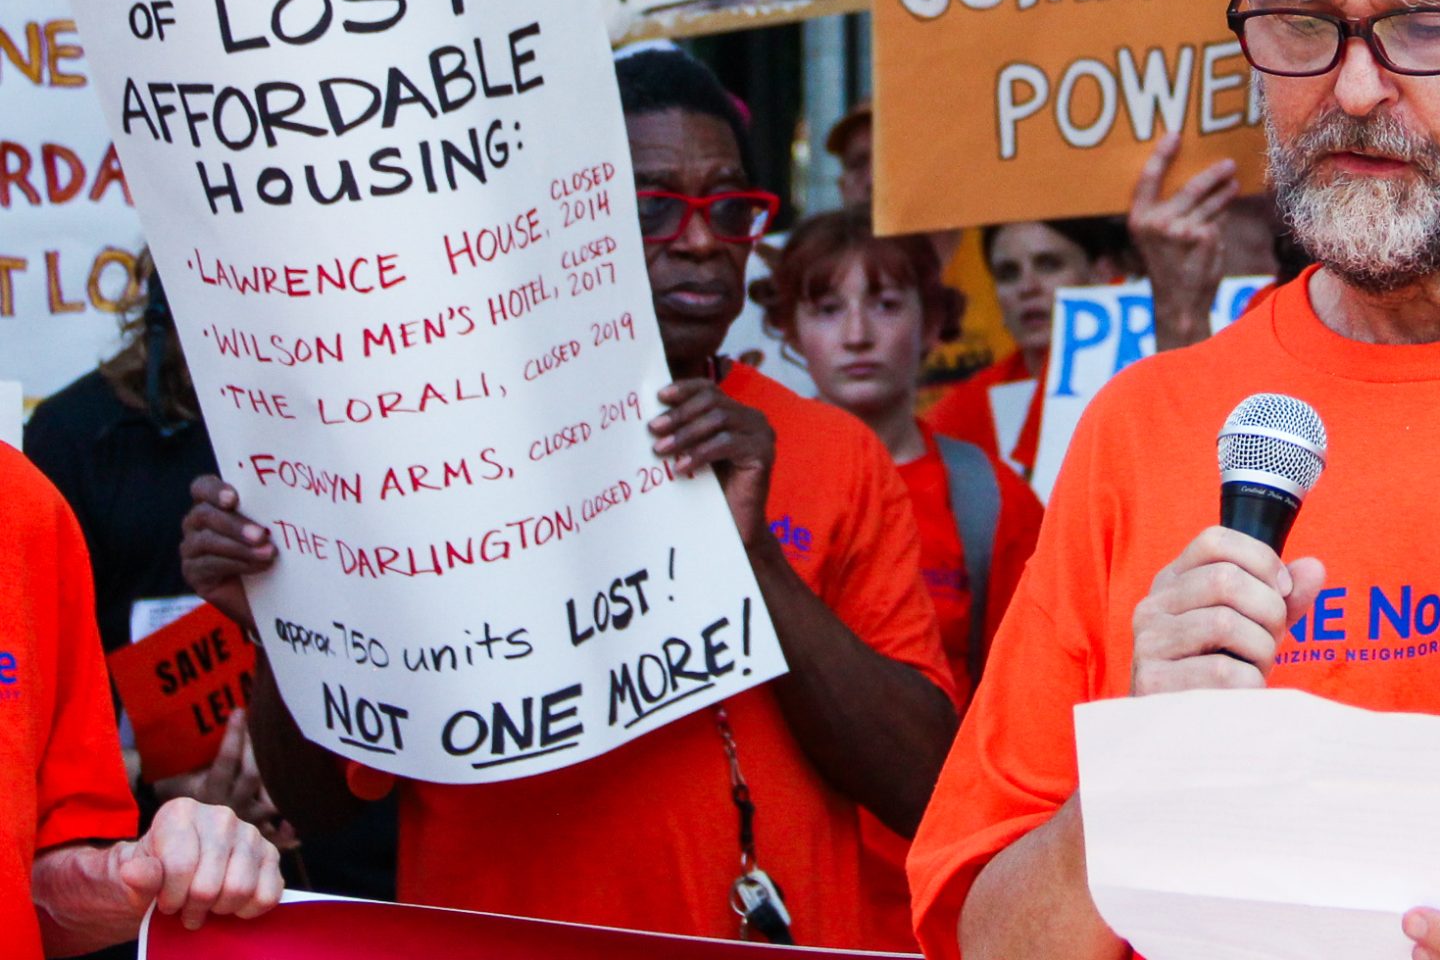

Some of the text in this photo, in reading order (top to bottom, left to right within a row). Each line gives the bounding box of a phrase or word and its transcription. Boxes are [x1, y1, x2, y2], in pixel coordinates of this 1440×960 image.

[129, 1, 175, 41] OF
[123, 23, 544, 150] AFFORDABLE
[998, 40, 1263, 161] POWE
[196, 120, 525, 215] HOUSING:
[551, 162, 615, 200] CLOSED
[560, 190, 610, 228] 2014
[195, 249, 406, 296] LAWRENCE
[562, 236, 617, 270] CLOSED
[568, 262, 615, 296] 2017
[216, 324, 343, 367] WILSON
[363, 306, 475, 359] MEN'S
[230, 384, 296, 420] THE
[523, 340, 581, 382] CLOSED
[591, 312, 636, 347] 2019
[380, 447, 515, 500] ARMS,
[528, 422, 591, 463] CLOSED
[600, 392, 642, 430] 2019
[273, 520, 328, 559] THE
[582, 480, 632, 522] CLOSED
[637, 455, 695, 494] 201
[156, 627, 231, 694] SAVE
[322, 597, 752, 756] NOT ONE MORE!
[333, 620, 390, 668] 750
[402, 623, 533, 674] units
